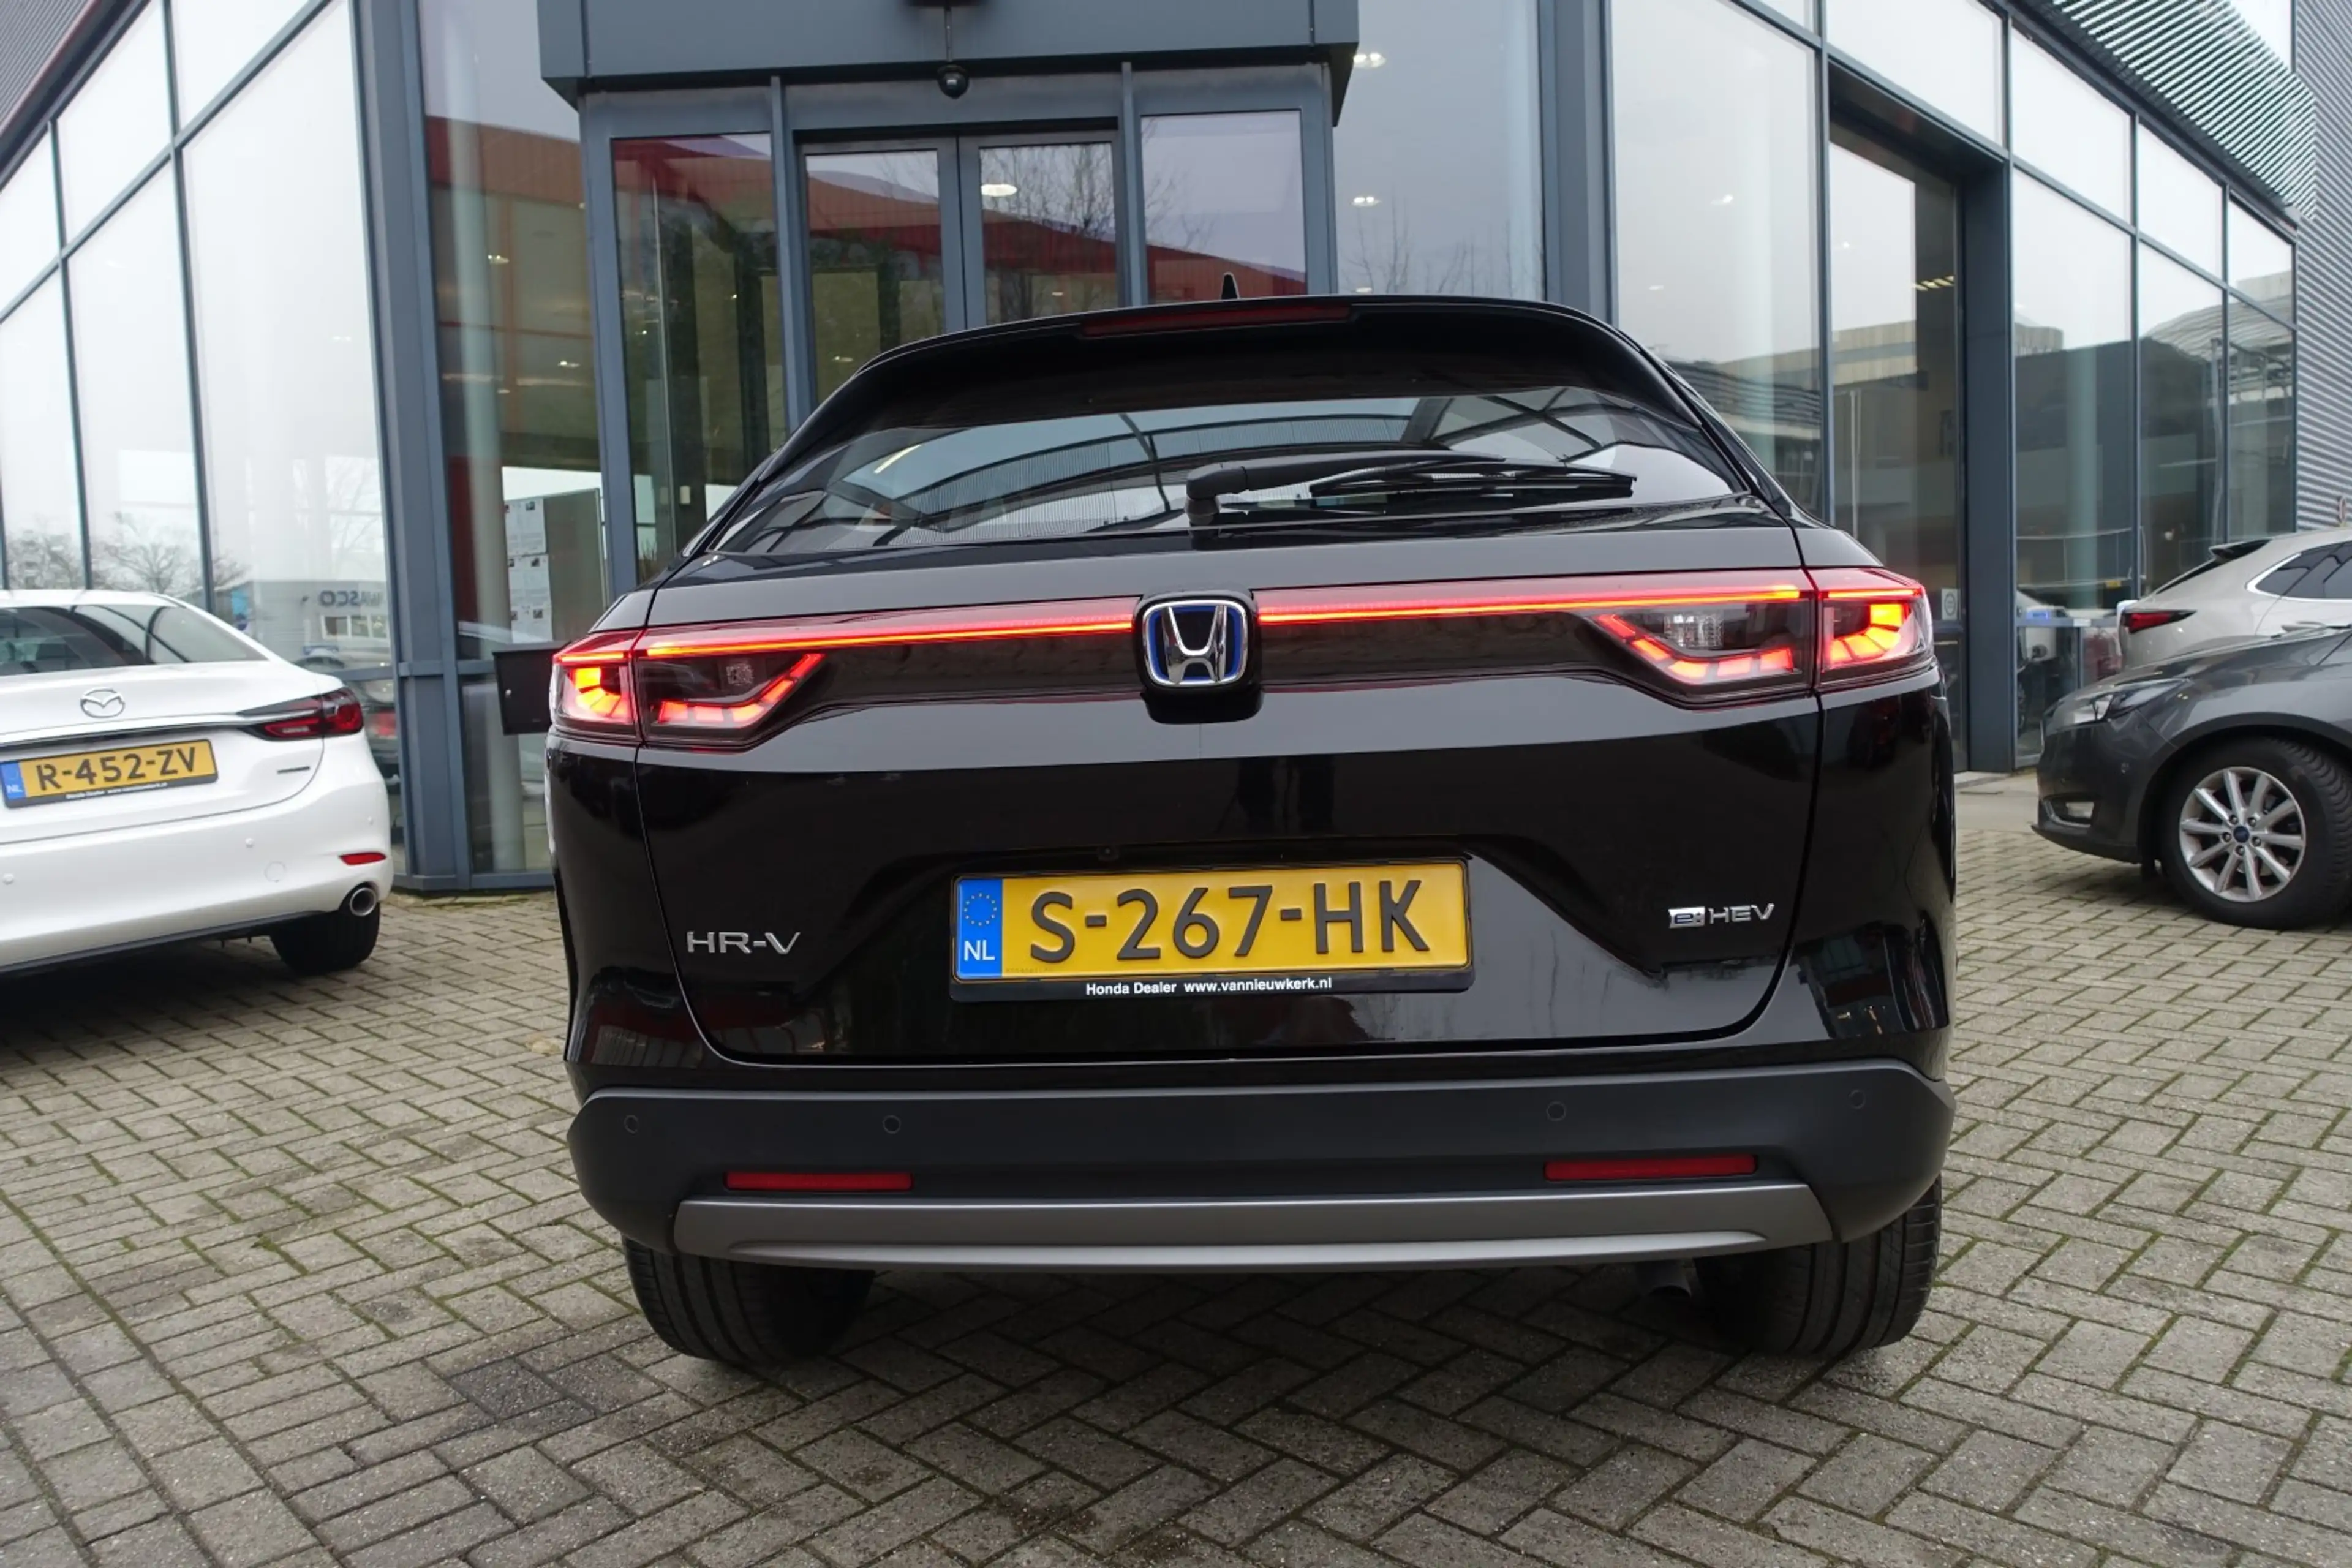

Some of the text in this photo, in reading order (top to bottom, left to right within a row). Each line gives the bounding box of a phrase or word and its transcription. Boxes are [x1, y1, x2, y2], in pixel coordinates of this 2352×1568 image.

[36, 747, 196, 791] R-452-ZV
[7, 784, 23, 793] NL
[1030, 880, 1430, 963] S-267-HK
[687, 931, 801, 955] HR-V
[963, 940, 995, 962] NL
[1086, 977, 1332, 995] Honda Dealer www.vannieuwkerk.nl
